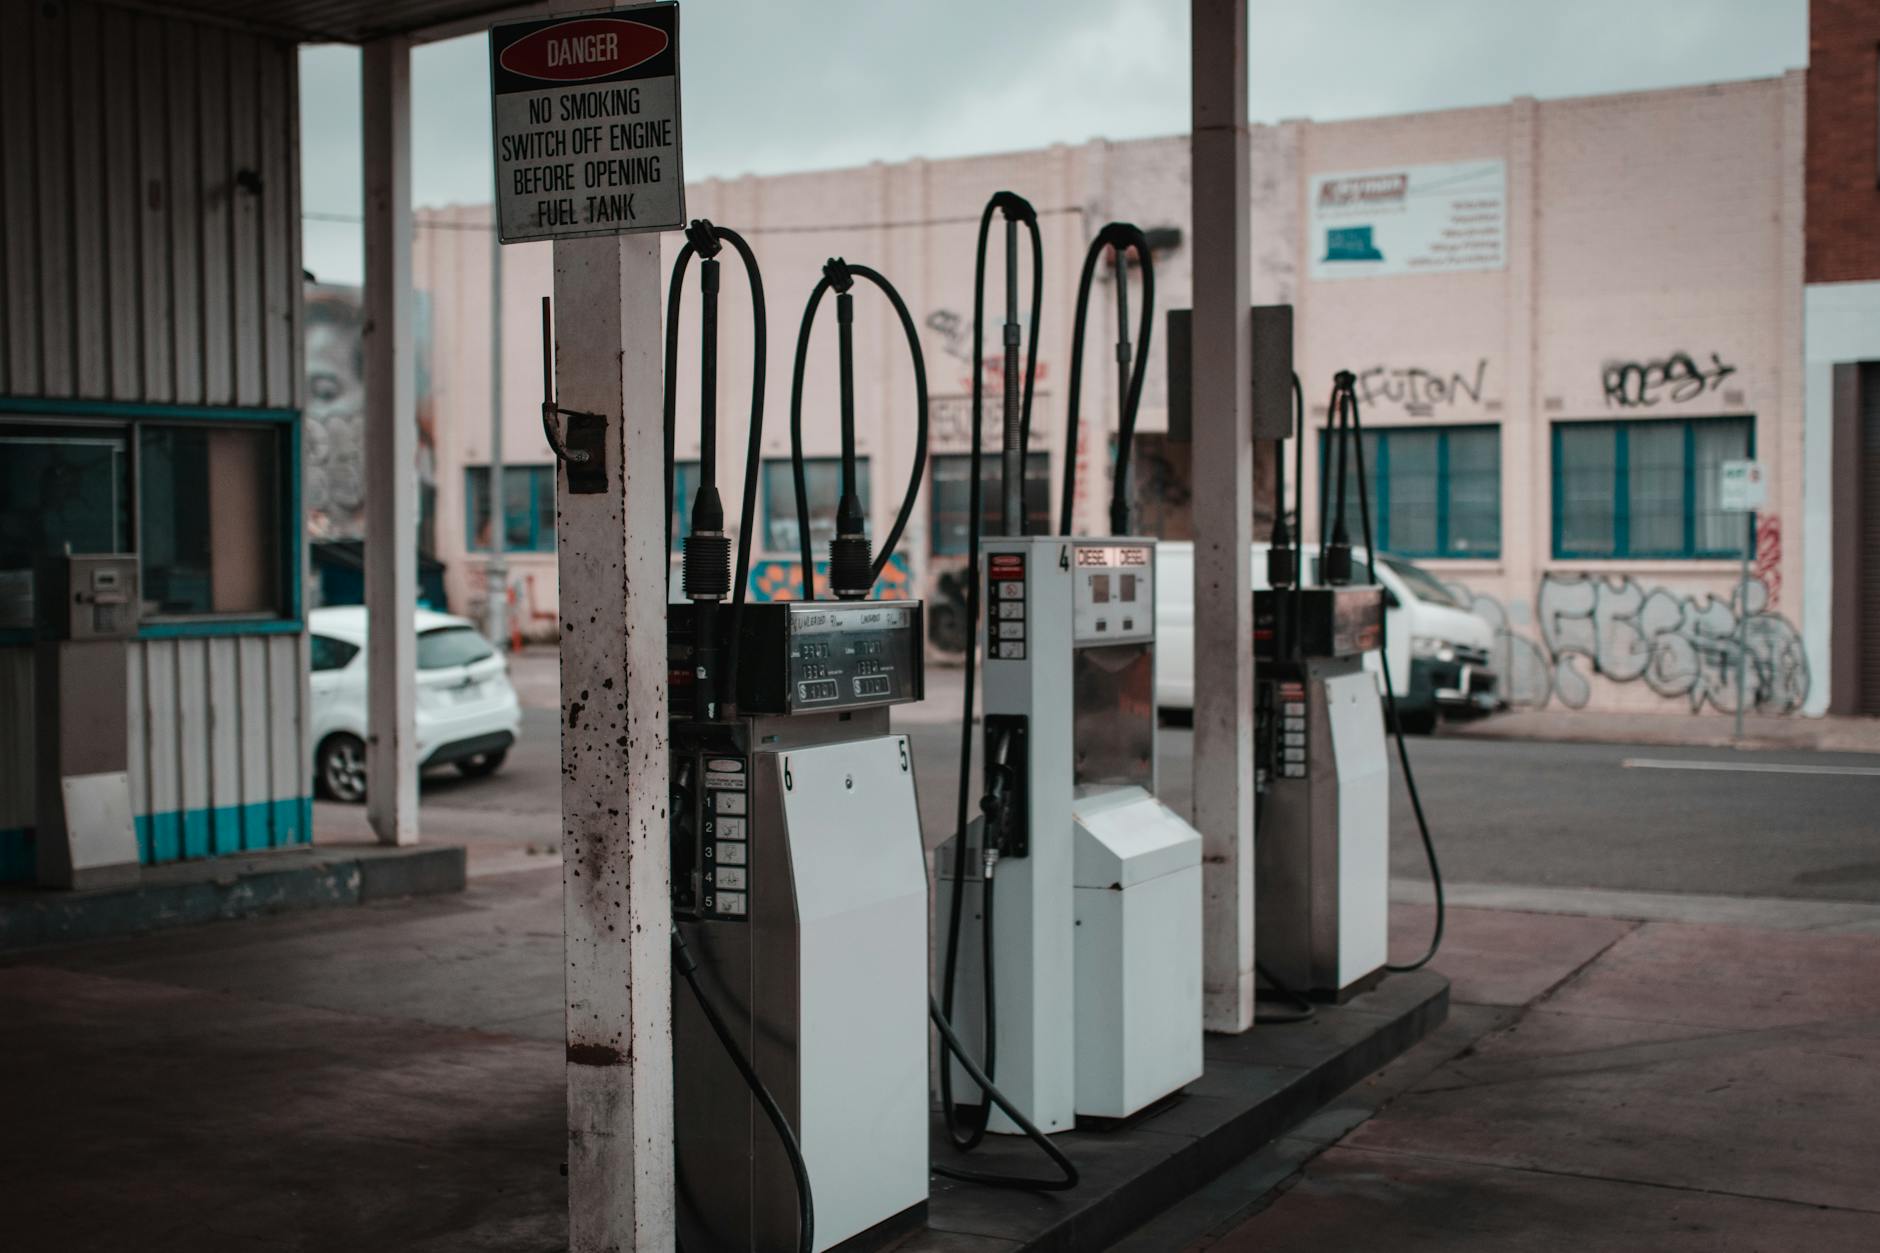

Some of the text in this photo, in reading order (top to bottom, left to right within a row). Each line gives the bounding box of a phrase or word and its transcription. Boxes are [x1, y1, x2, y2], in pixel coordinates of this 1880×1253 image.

[547, 33, 619, 67] DANGER
[529, 88, 640, 125] NO SMOKING
[502, 119, 672, 162] SWITCH OFF ENGINE
[514, 156, 661, 195] BEFORE OPENING
[538, 193, 636, 228] FUEL TANK
[1059, 544, 1070, 572] 4
[784, 756, 793, 791] 6
[898, 740, 908, 772] 5
